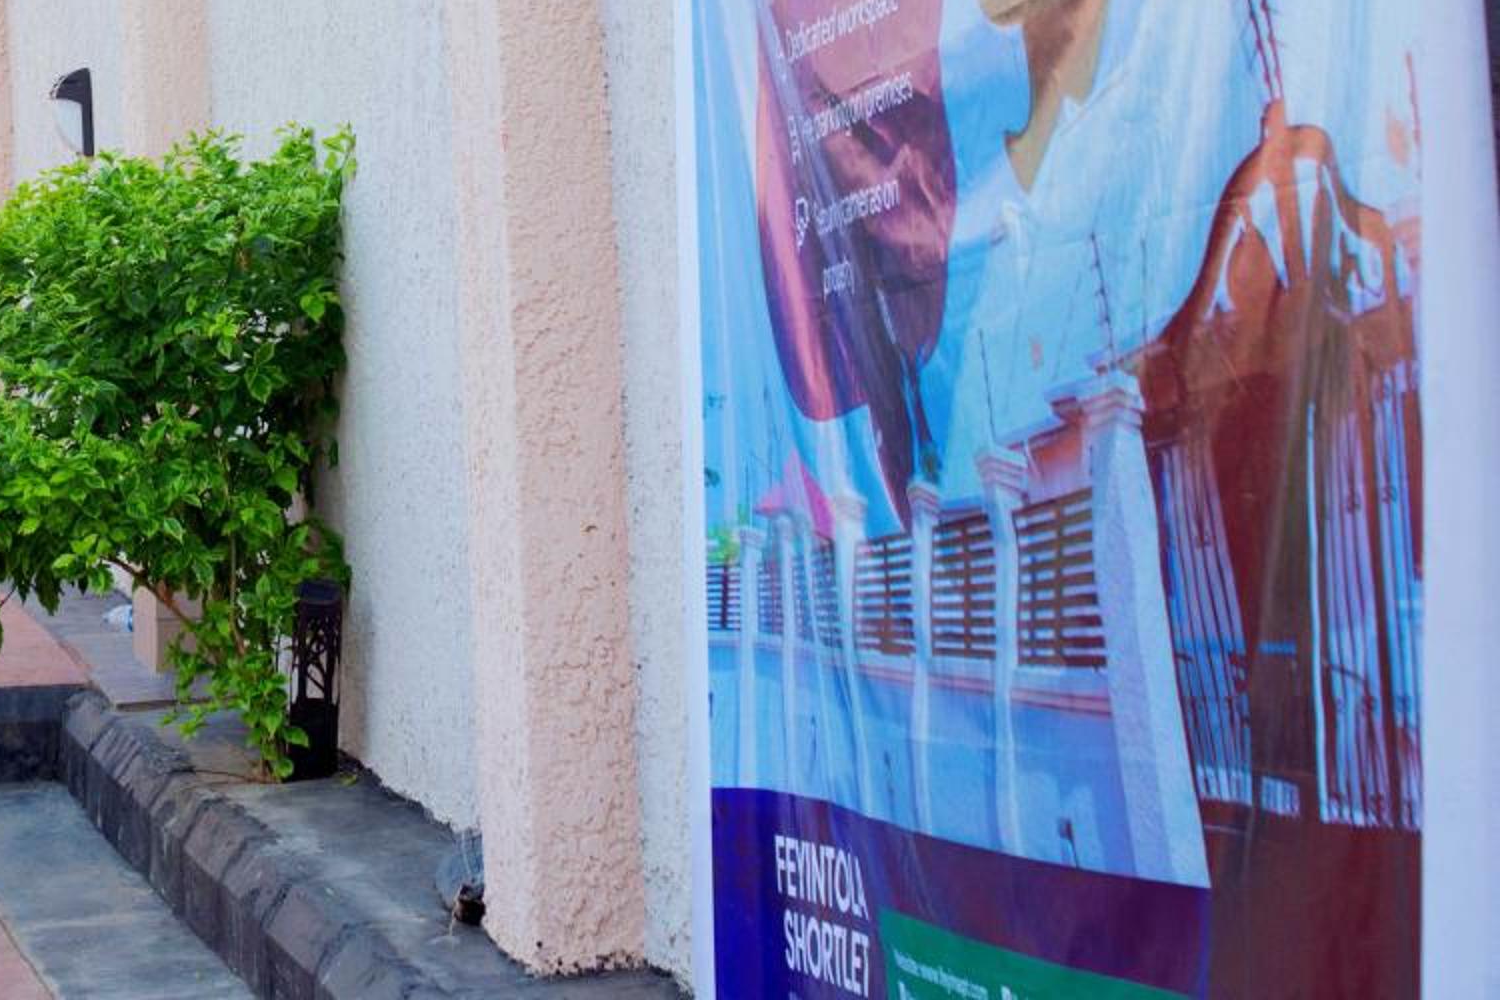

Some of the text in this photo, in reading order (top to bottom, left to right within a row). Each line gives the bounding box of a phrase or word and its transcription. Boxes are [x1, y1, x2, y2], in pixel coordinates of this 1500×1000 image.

[785, 5, 836, 64] Dedicated
[865, 71, 913, 118] premises
[882, 179, 900, 211] on
[783, 908, 870, 997] SHORTLET
